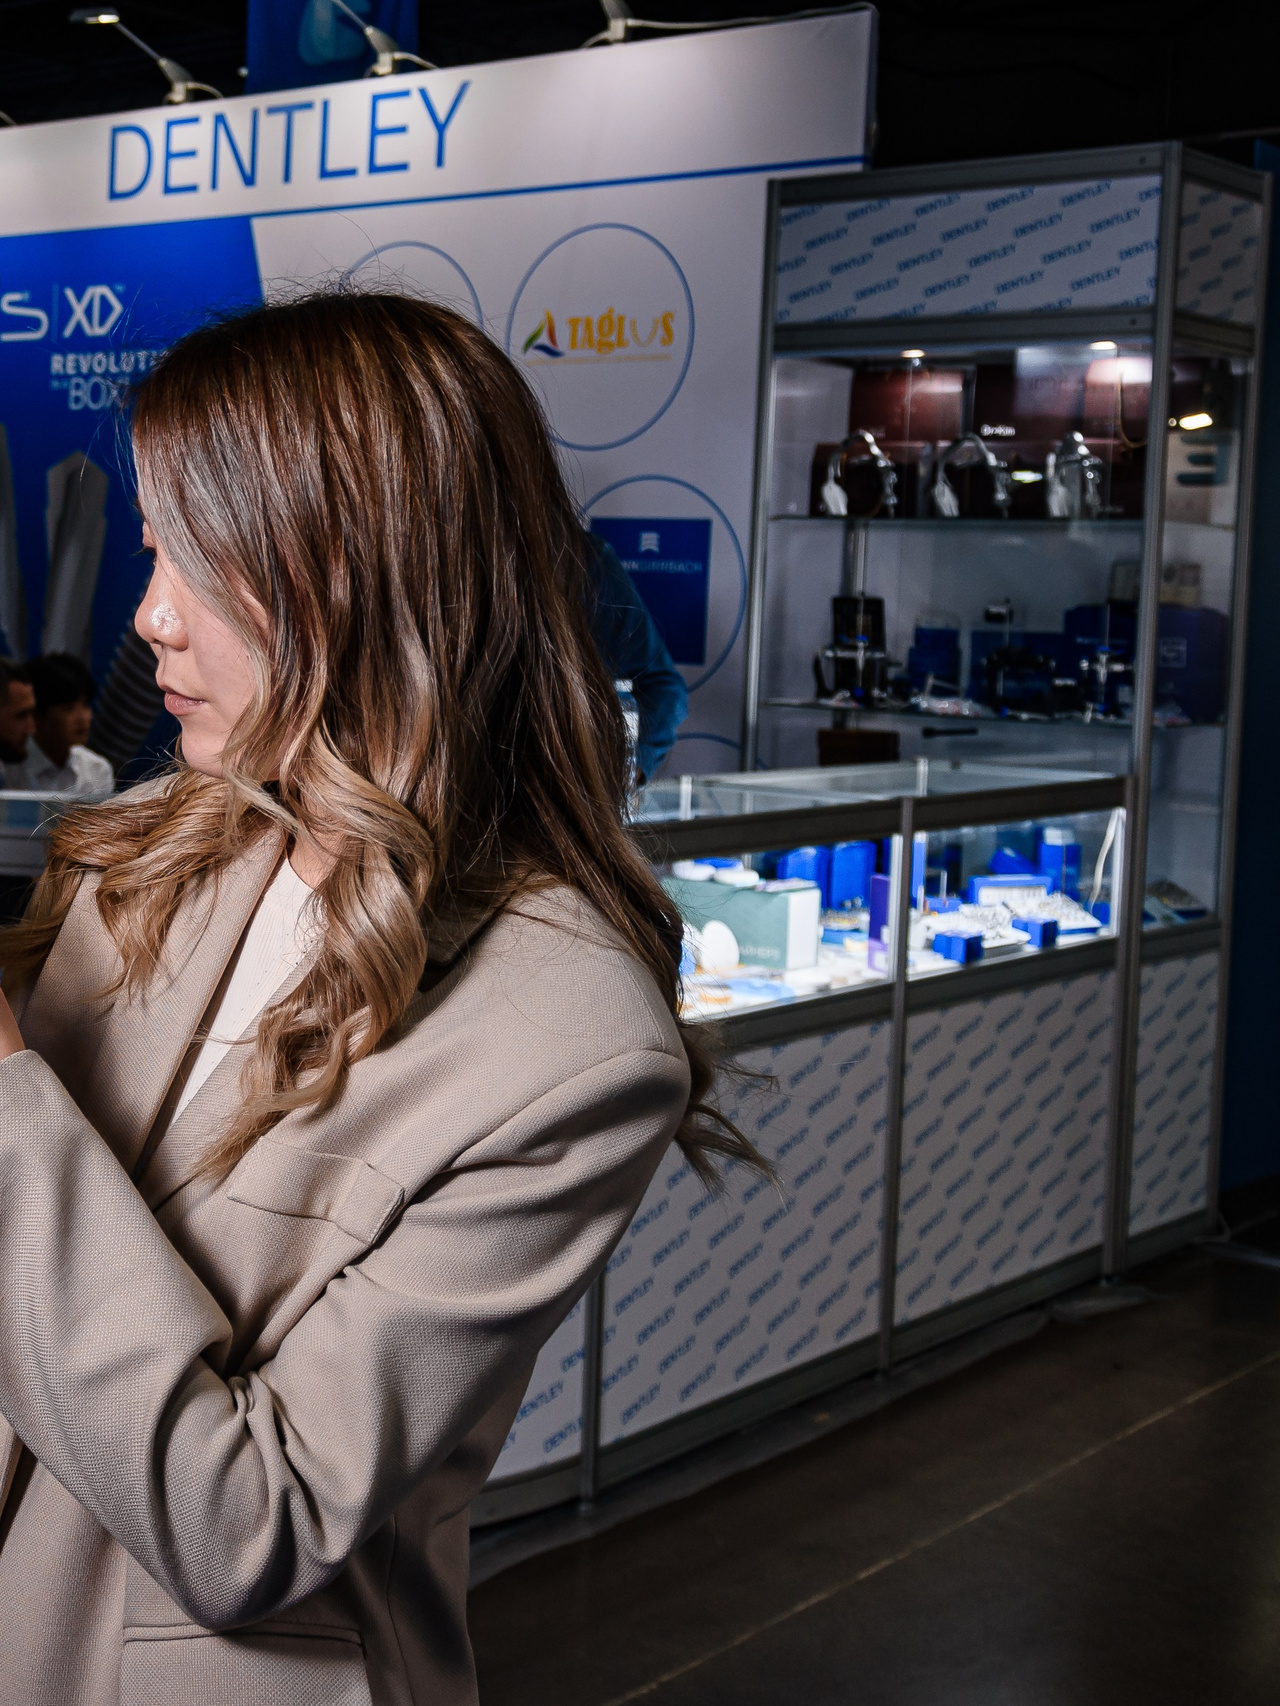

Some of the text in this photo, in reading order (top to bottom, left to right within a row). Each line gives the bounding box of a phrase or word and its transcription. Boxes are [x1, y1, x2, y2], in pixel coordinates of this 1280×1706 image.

[107, 81, 470, 202] DENTLEY
[913, 194, 960, 217] DENTLEY
[985, 187, 1035, 213] DENTLEY
[1060, 179, 1112, 208] DENTLEY
[940, 217, 988, 243] DENTLEY
[1013, 213, 1063, 238] DENTLEY
[1089, 208, 1140, 234] DENTLEY
[804, 227, 848, 251] DENTLEY
[870, 222, 917, 247] DENTLEY
[828, 252, 874, 276] DENTLEY
[896, 248, 943, 272] DENTLEY
[967, 244, 1015, 268] DENTLEY
[1041, 240, 1091, 264] DENTLEY
[854, 278, 899, 301] DENTLEY
[923, 274, 970, 298] DENTLEY
[995, 270, 1044, 294] DENTLEY
[1070, 267, 1121, 291] DENTLEY
[787, 281, 831, 304] DENTLEY
